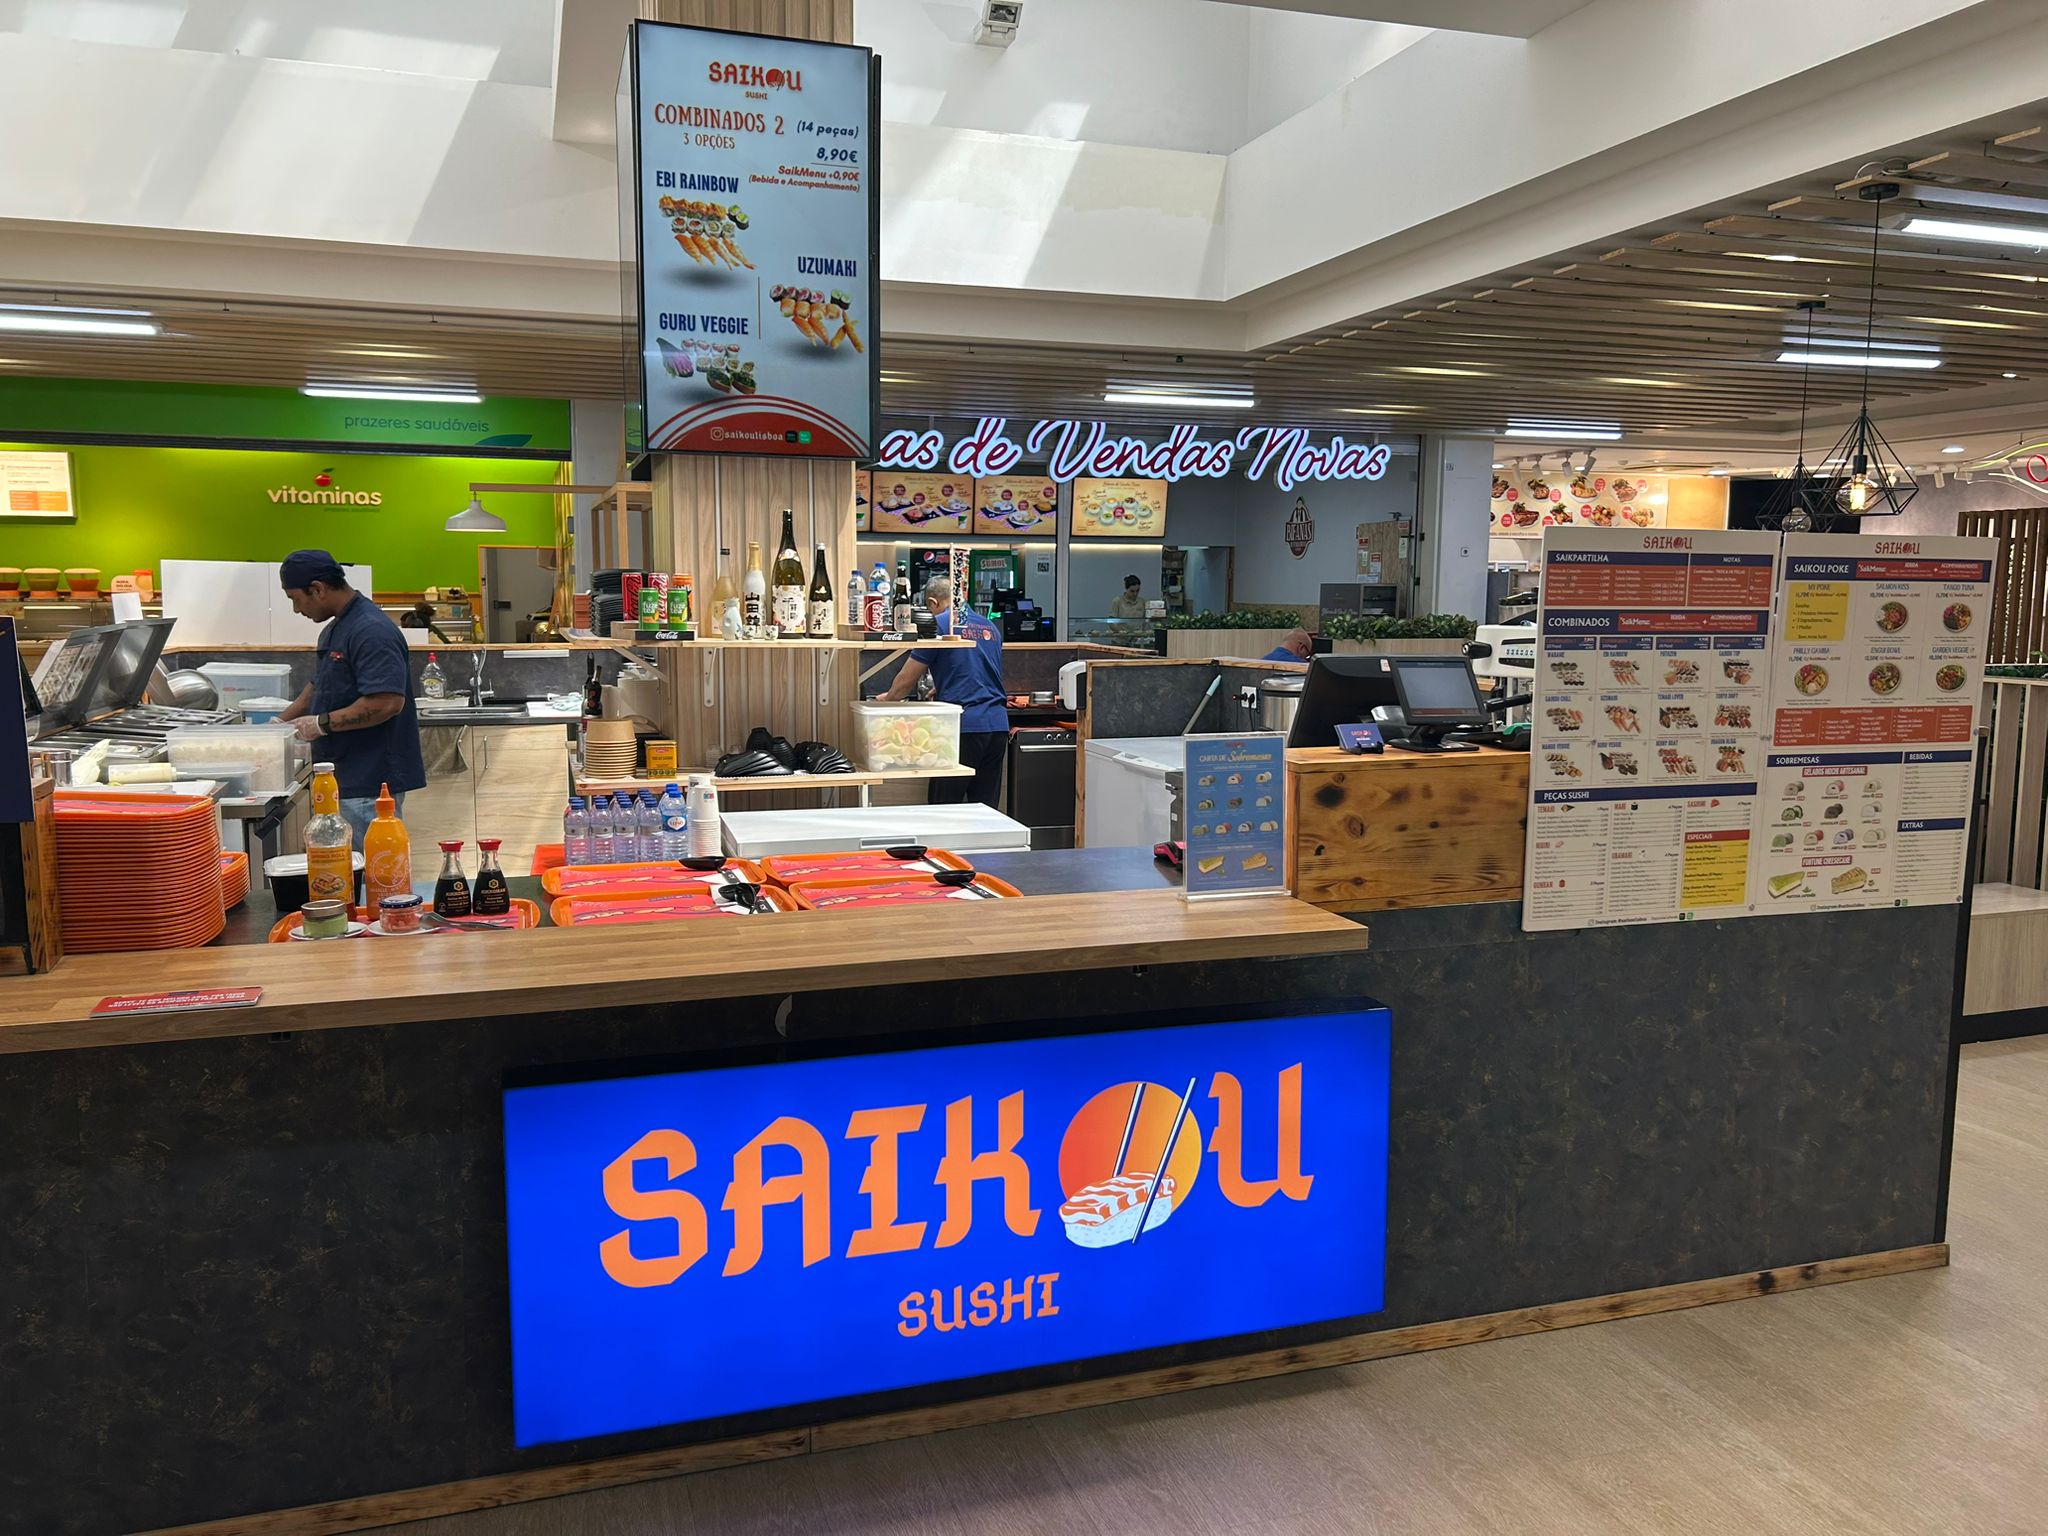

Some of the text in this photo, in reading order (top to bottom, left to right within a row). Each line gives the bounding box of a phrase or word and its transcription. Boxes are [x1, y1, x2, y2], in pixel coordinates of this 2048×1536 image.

[708, 61, 802, 91] SAIKOU
[745, 91, 768, 100] SUSHI
[655, 103, 785, 135] COMBINADOS 2
[796, 120, 859, 138] (14 peças)
[683, 133, 735, 150] 3 OPÇÕES
[816, 147, 858, 163] 8,90€
[778, 165, 827, 179] SaikMenu
[656, 170, 739, 193] EBI RAINBOW
[748, 174, 861, 193] (Bebida e Acompanhamento)
[797, 256, 857, 277] UZUMAKI
[659, 312, 749, 335] GURU VEGGIE
[344, 416, 490, 432] prazeres saudáveis
[949, 417, 1023, 478] de
[1027, 420, 1234, 483] Vendas
[1236, 427, 1391, 491] Novas
[267, 485, 382, 505] vitaminas
[1286, 523, 1312, 541] BIFANAS
[1643, 536, 1692, 549] SAIKOU
[1875, 542, 1920, 555] SAIKOU
[981, 558, 1007, 569] SUMOL
[1555, 553, 1609, 563] SAIKPARTILHA
[1794, 563, 1849, 573] SAIKOU POKE
[872, 604, 880, 628] SUPER
[1548, 617, 1610, 627] COMBINADOS
[1776, 757, 1820, 765] SOBREMESAS
[1543, 791, 1590, 800] PEÇAS SUSHI
[1902, 821, 1924, 829] EXTRAS
[600, 1062, 1315, 1288] SAIKOU
[897, 1271, 1060, 1338] SUSHI
